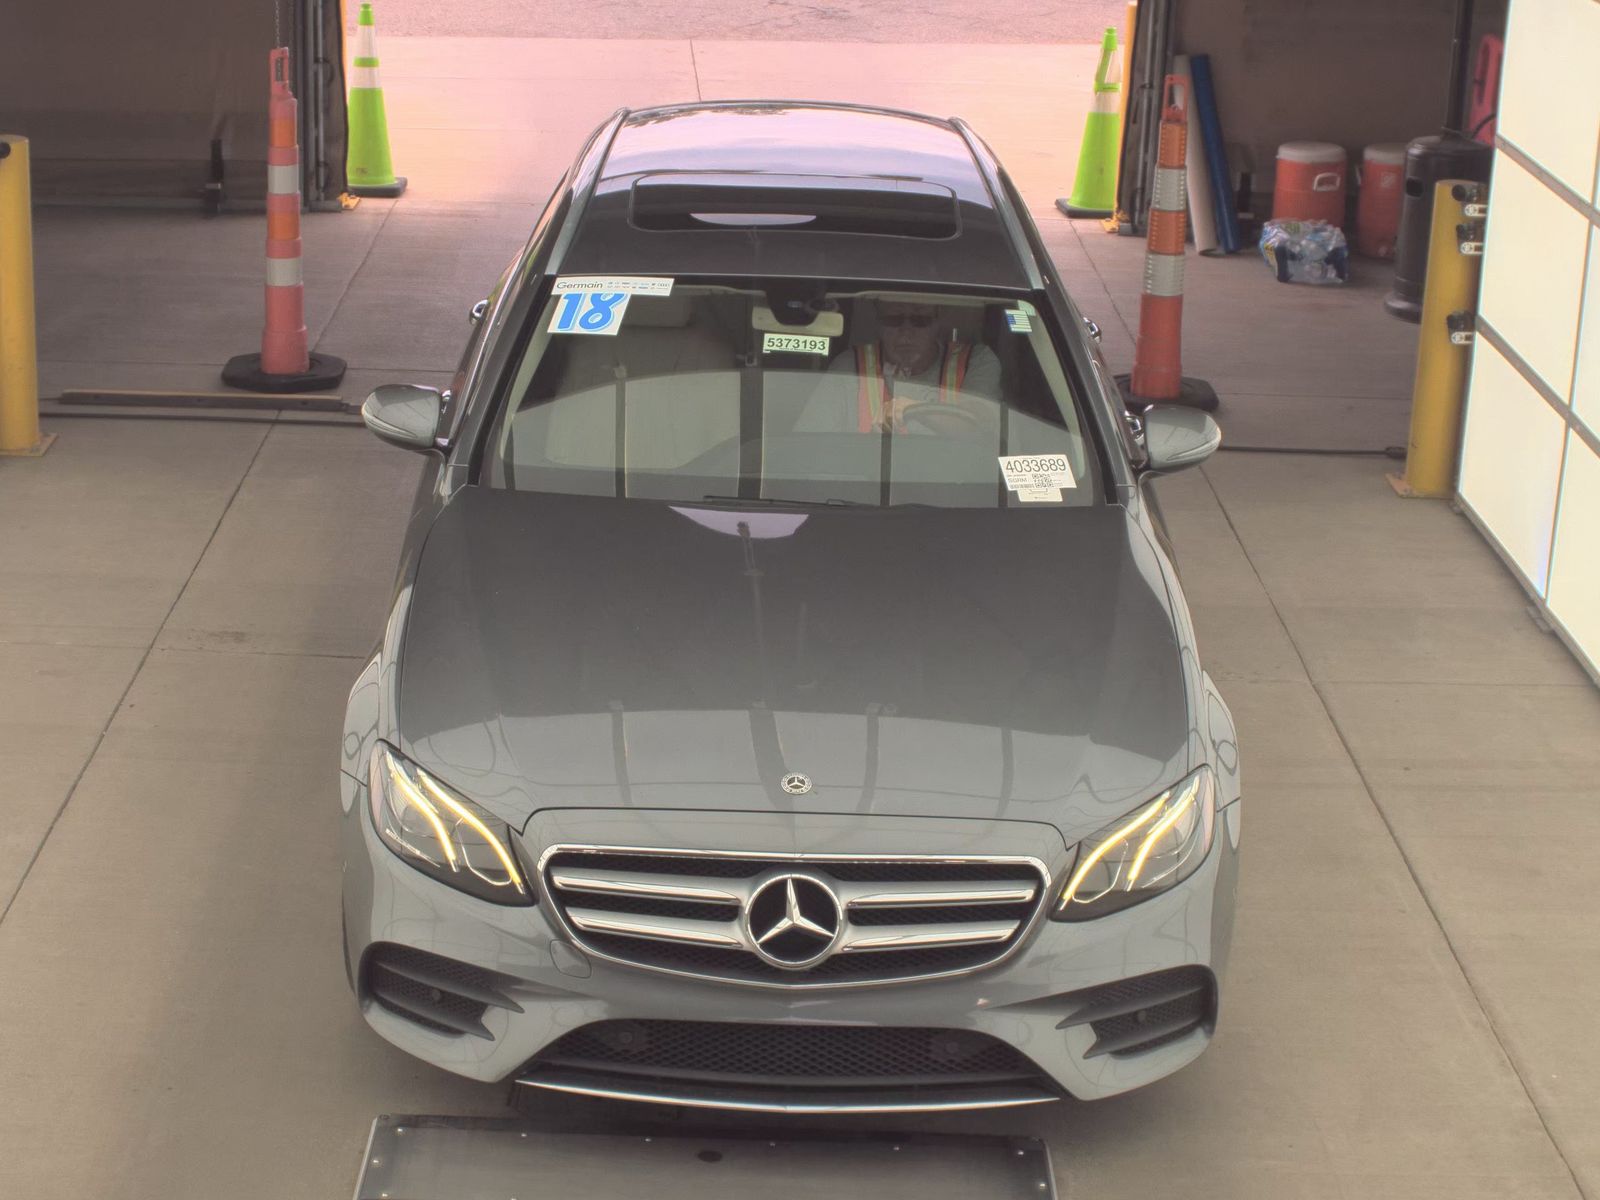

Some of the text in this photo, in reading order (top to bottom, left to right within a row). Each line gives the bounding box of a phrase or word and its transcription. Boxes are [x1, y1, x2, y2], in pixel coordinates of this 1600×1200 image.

[557, 281, 603, 289] Germain
[556, 293, 627, 331] 18
[767, 337, 826, 351] 5373193
[1006, 458, 1067, 473] 4033689
